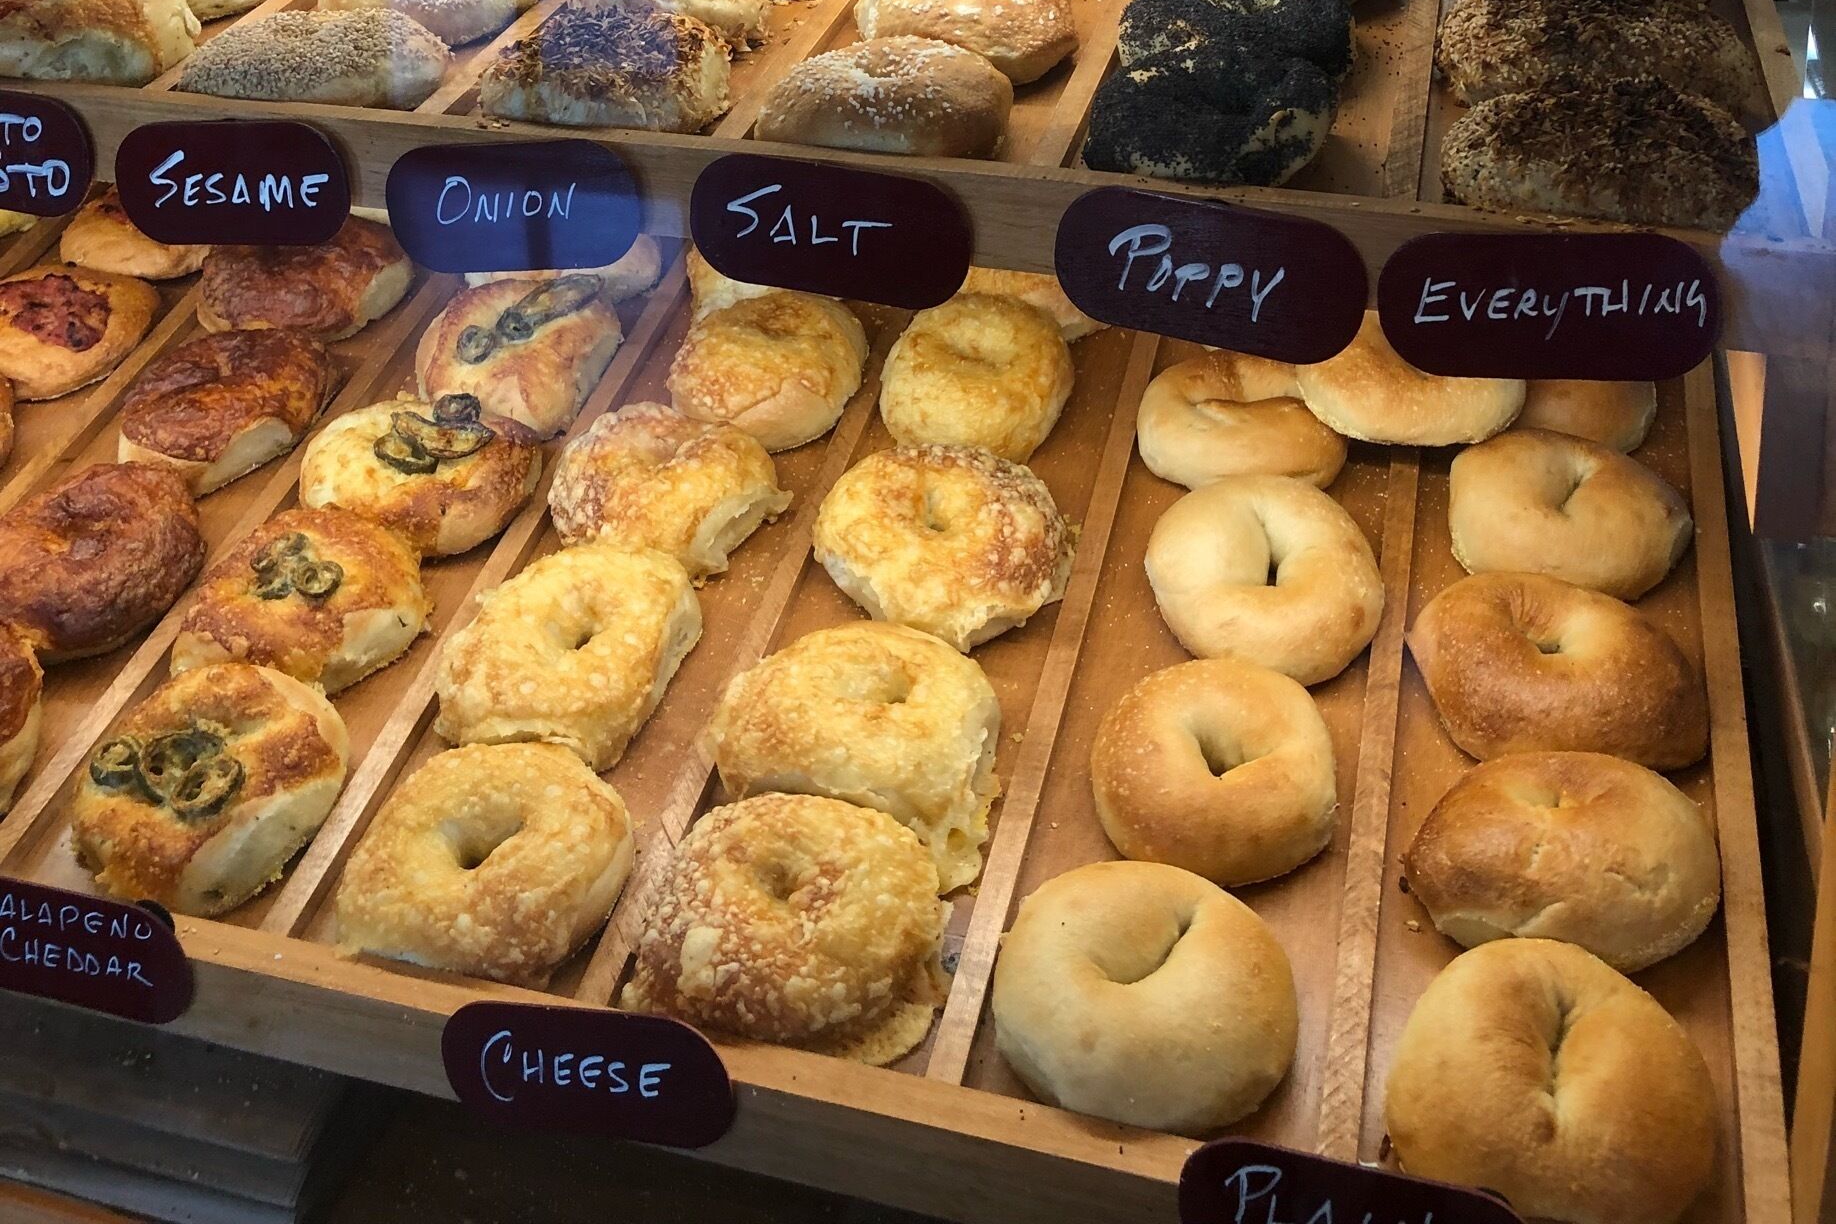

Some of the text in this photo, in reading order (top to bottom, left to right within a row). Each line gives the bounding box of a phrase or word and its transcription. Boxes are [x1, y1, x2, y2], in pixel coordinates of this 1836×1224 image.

[149, 149, 329, 212] SESAME
[436, 177, 577, 224] ONION
[726, 184, 893, 255] SALT
[1108, 223, 1285, 322] POPPY
[1413, 277, 1708, 340] EVERYTHING
[0, 927, 154, 987] CHEDDAR
[480, 1030, 671, 1102] CHEESE
